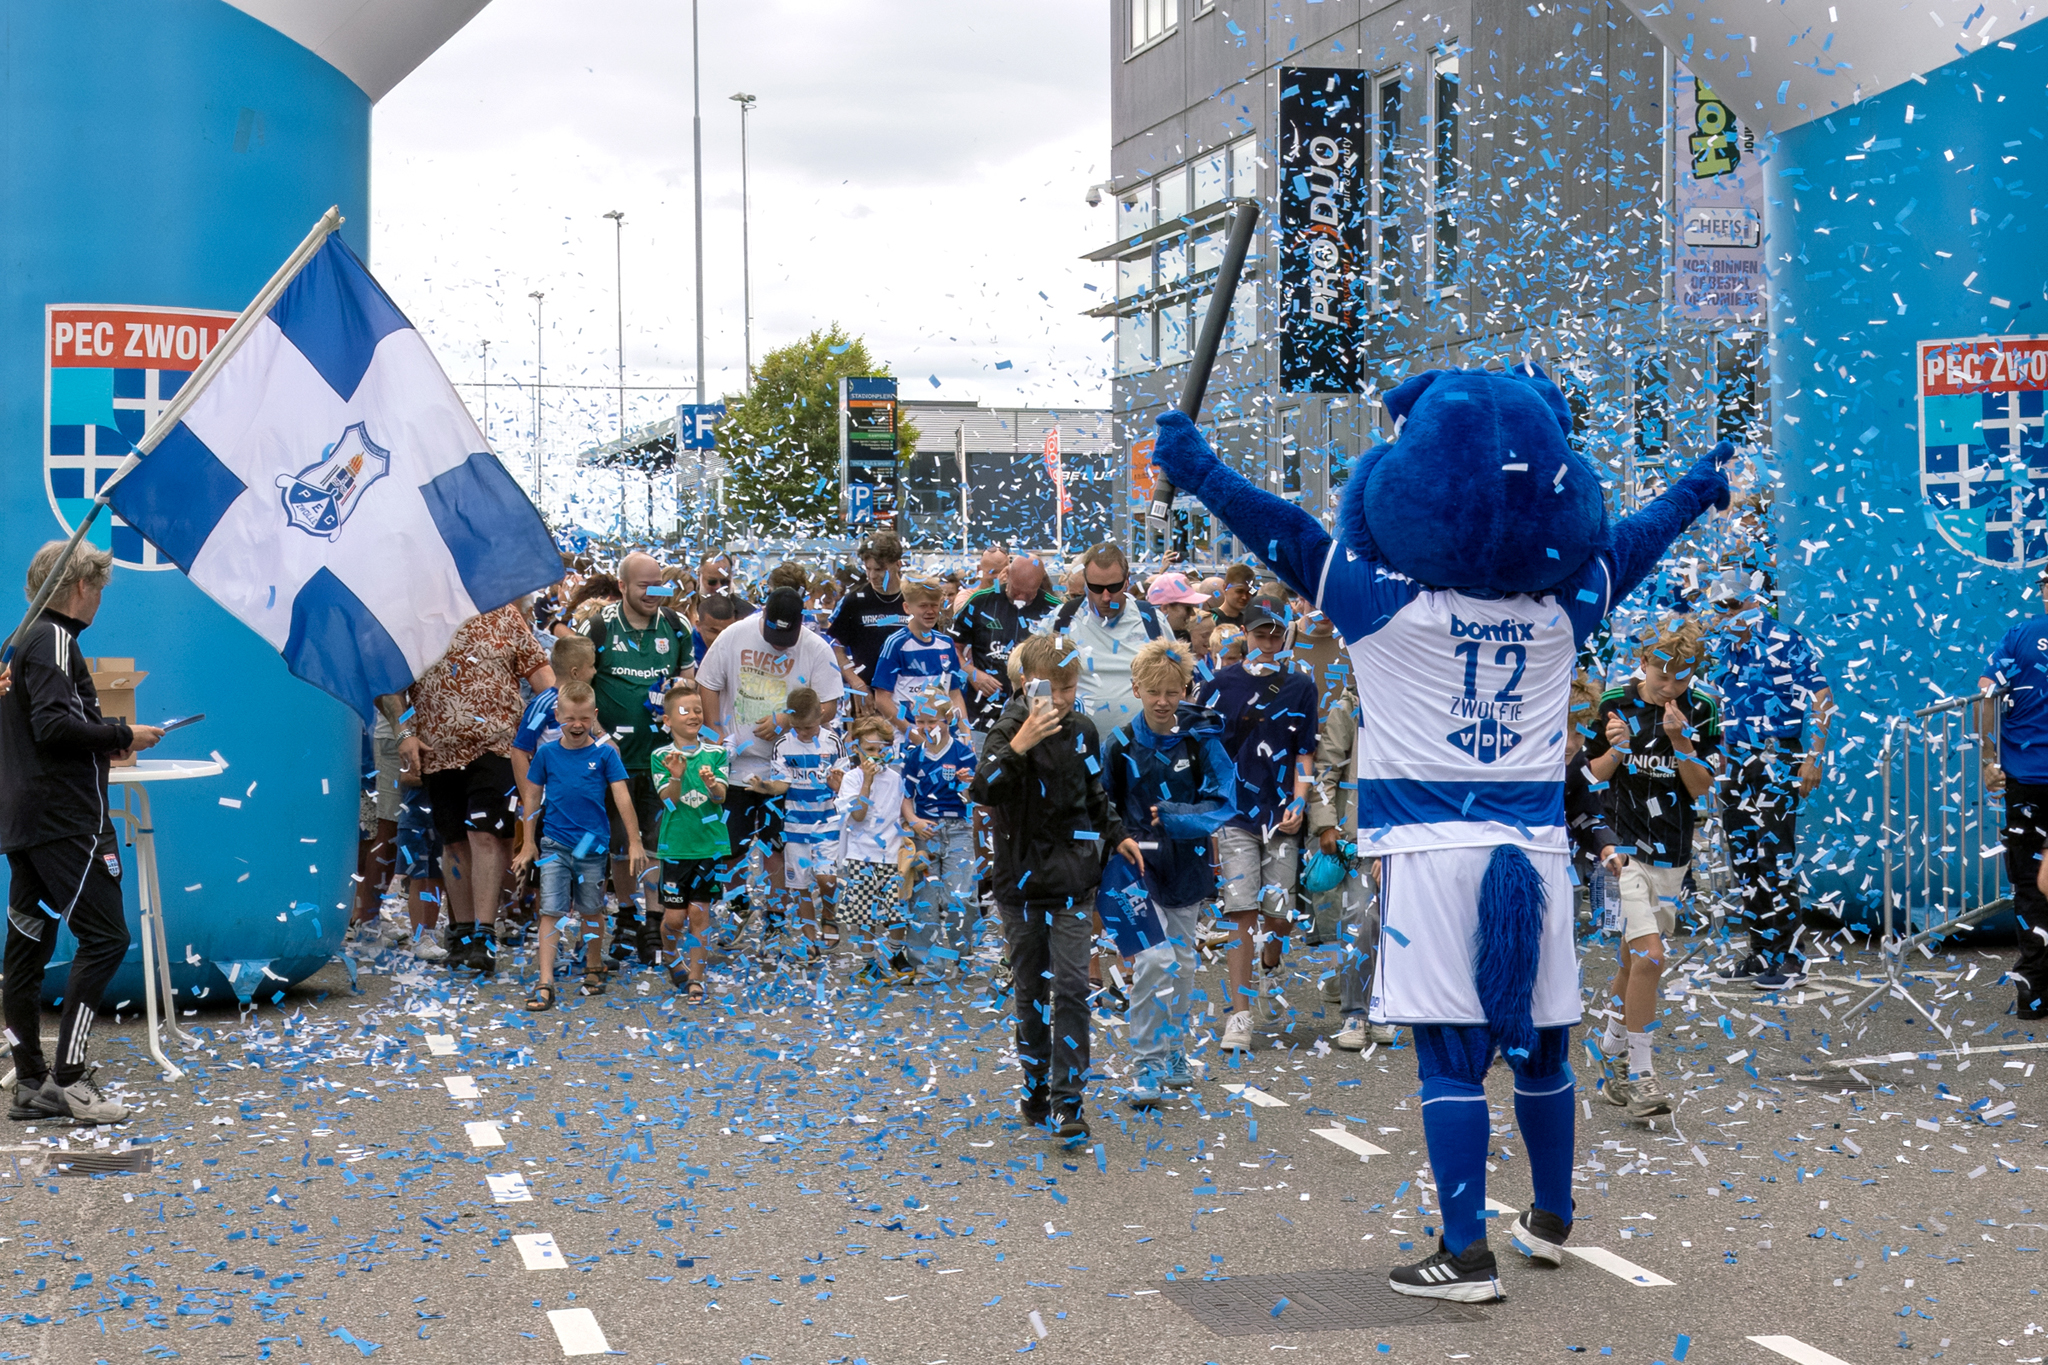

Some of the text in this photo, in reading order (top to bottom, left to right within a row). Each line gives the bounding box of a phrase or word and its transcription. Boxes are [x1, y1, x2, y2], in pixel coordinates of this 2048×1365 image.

[1309, 135, 1340, 226] DUO
[1713, 260, 1758, 274] BINNEN
[55, 322, 226, 361] PEC ZWOL
[1927, 353, 1985, 386] PEC
[855, 486, 870, 506] P
[1450, 613, 1535, 643] bonfix
[611, 666, 670, 679] zonneplan
[740, 649, 795, 678] EVERY
[1455, 640, 1527, 703] 12
[1460, 733, 1514, 747] VDK
